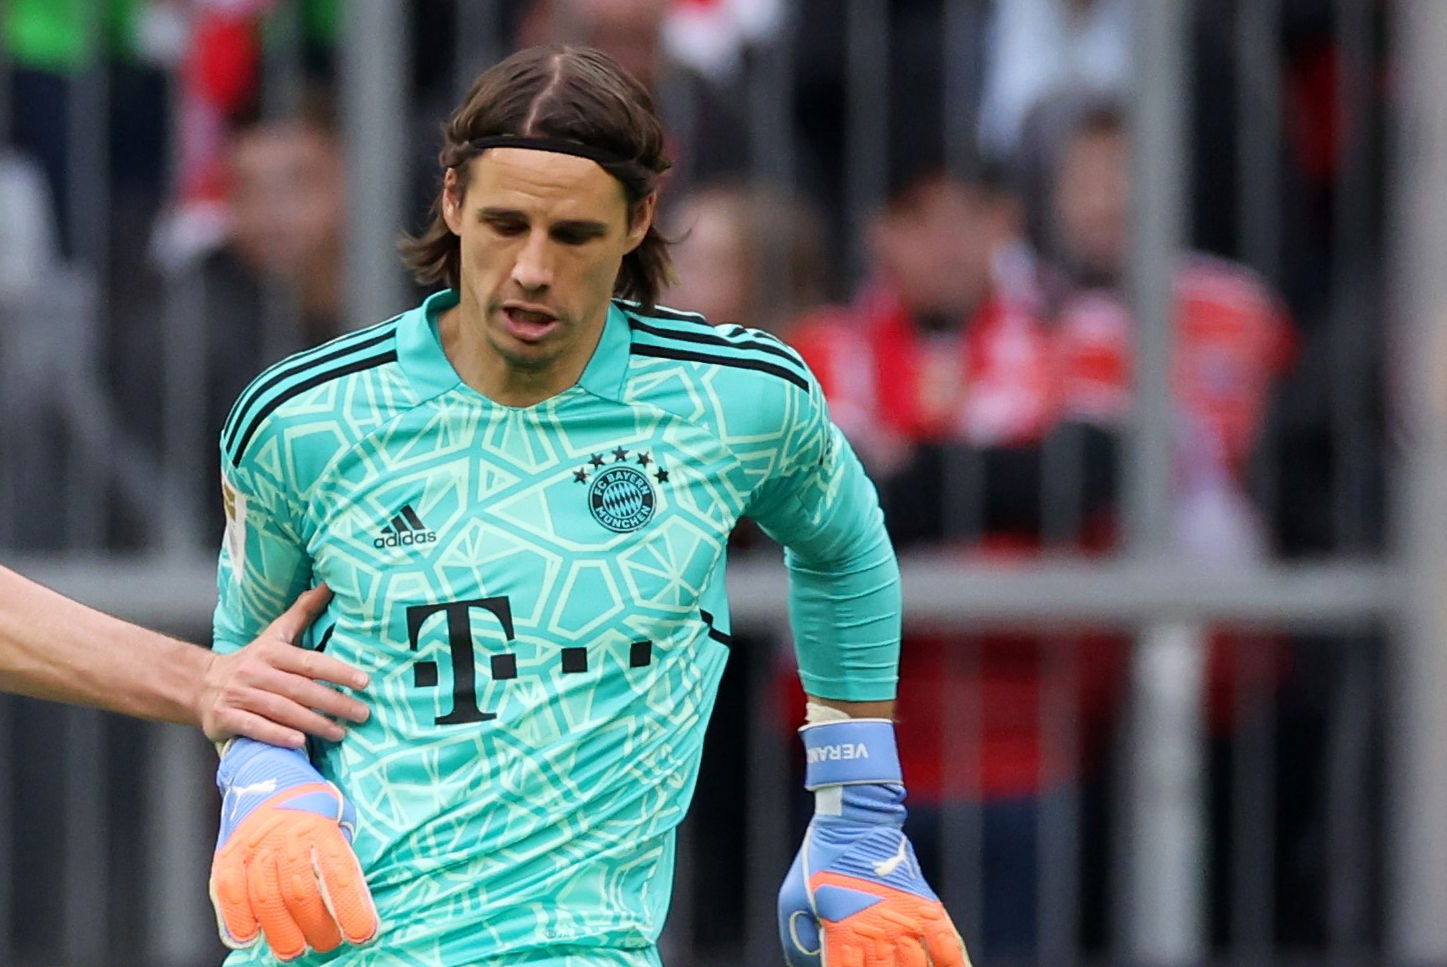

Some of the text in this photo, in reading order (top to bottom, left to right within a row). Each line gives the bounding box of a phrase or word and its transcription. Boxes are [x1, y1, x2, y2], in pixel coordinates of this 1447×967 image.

[594, 471, 650, 496] FC BAYERN
[373, 530, 437, 549] adidas
